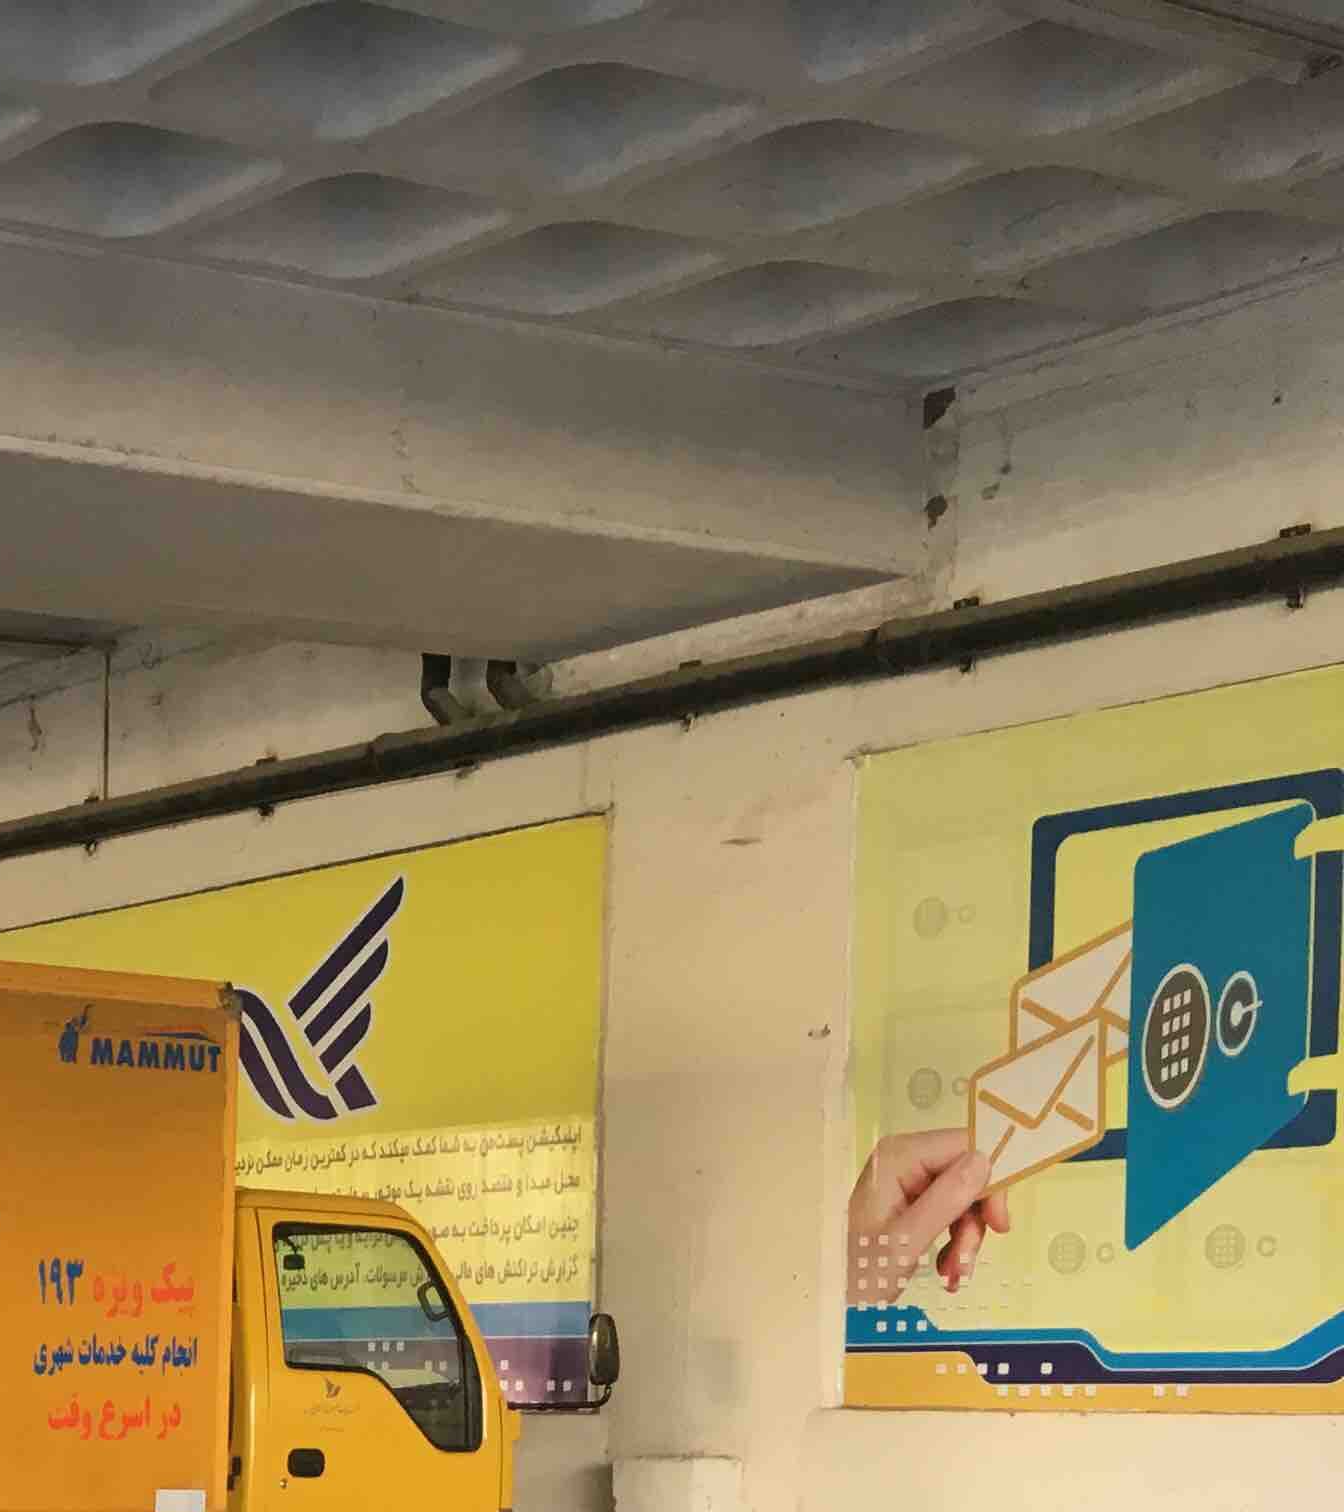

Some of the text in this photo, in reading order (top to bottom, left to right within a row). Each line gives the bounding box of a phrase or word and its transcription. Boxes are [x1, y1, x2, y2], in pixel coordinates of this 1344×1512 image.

[90, 1036, 221, 1073] MAMMUT
[38, 1256, 195, 1318] پیک ویژه ۱۹۳
[33, 1332, 198, 1377] انجام کلیه خدمات شهری
[47, 1392, 181, 1441] در اسرع وقت
